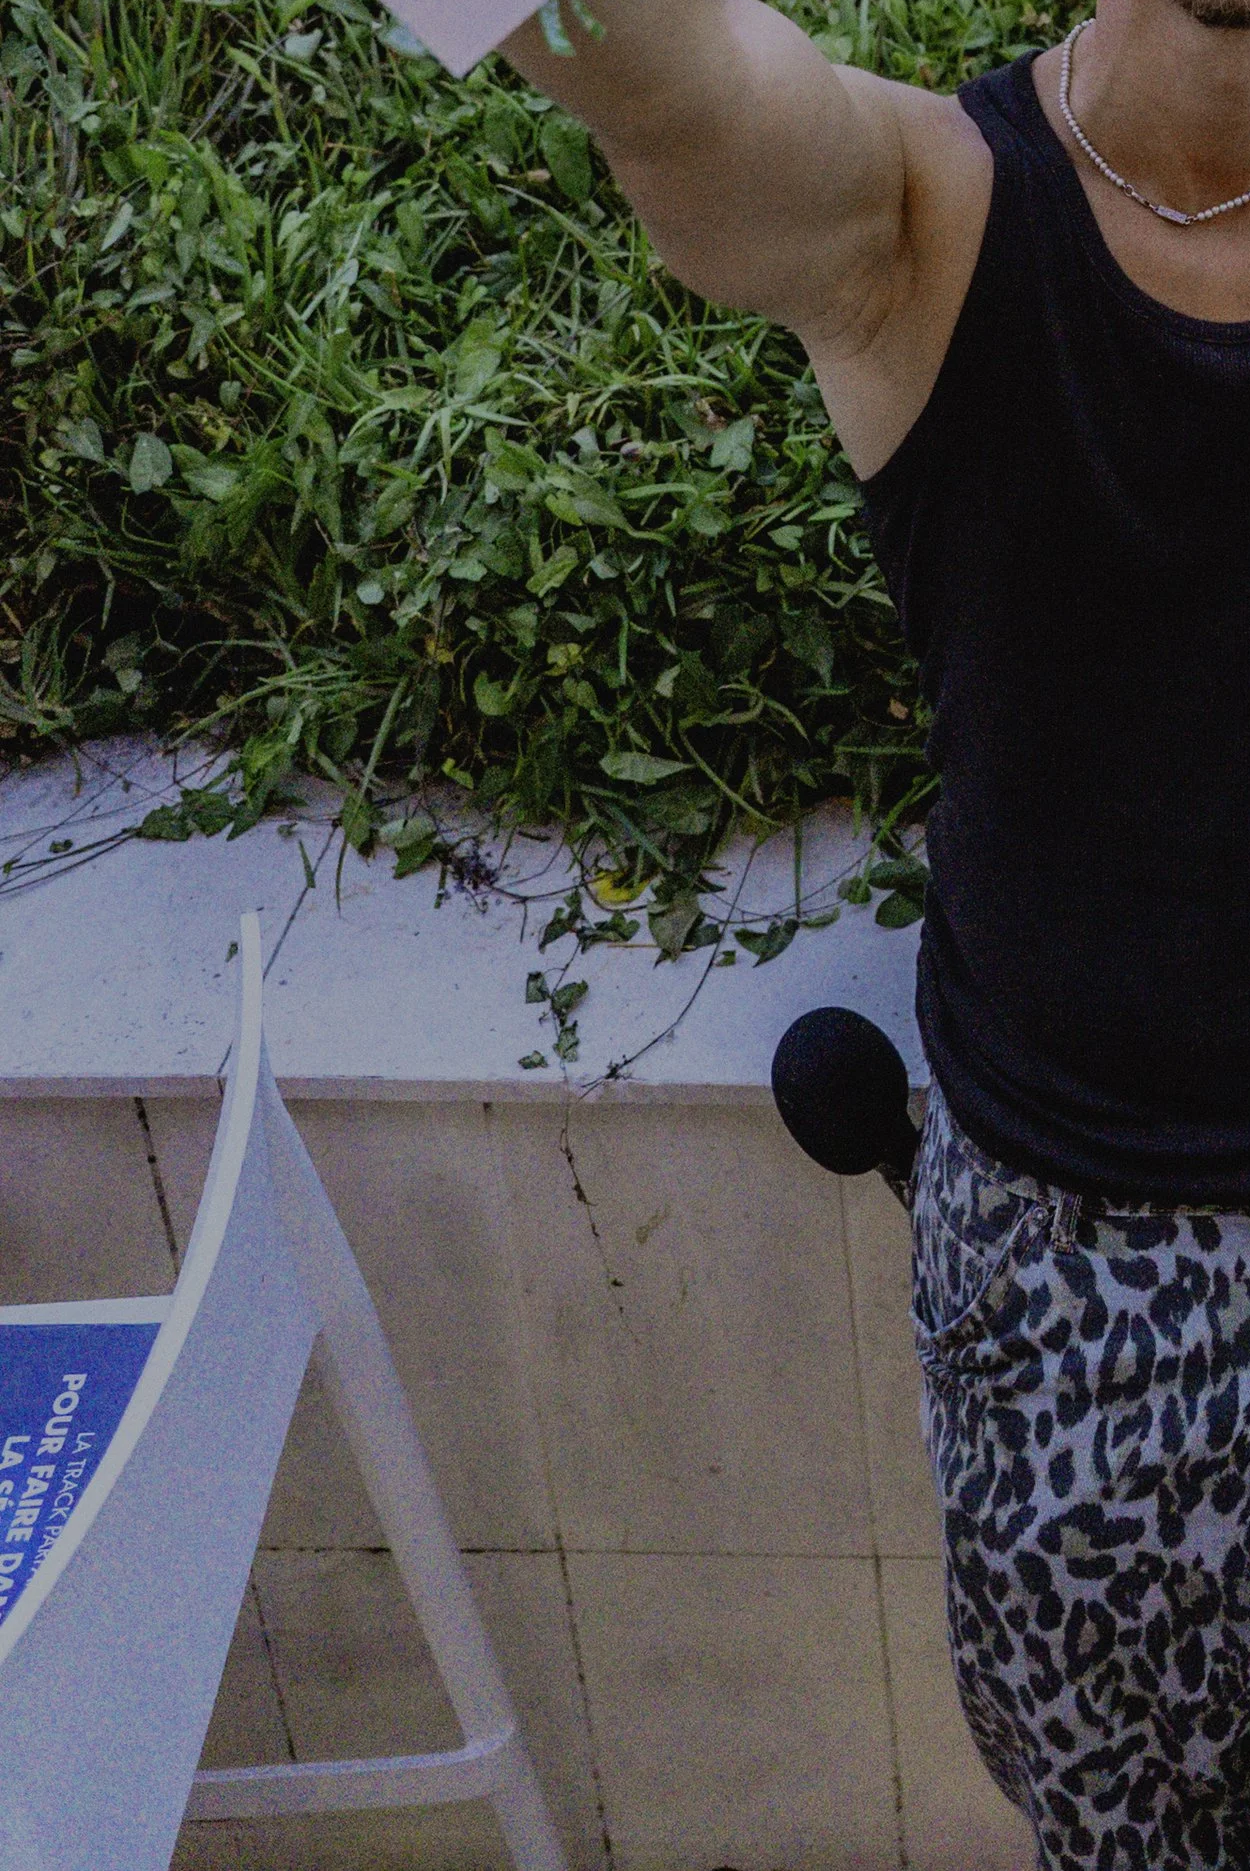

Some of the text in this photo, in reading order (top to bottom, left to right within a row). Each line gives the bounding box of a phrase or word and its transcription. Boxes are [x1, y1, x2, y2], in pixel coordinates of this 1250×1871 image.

[36, 1372, 88, 1457] POUR
[72, 1432, 96, 1455] LA
[0, 1435, 31, 1470] LA
[4, 1464, 56, 1543] FAIRE
[47, 1459, 87, 1520] TRACK
